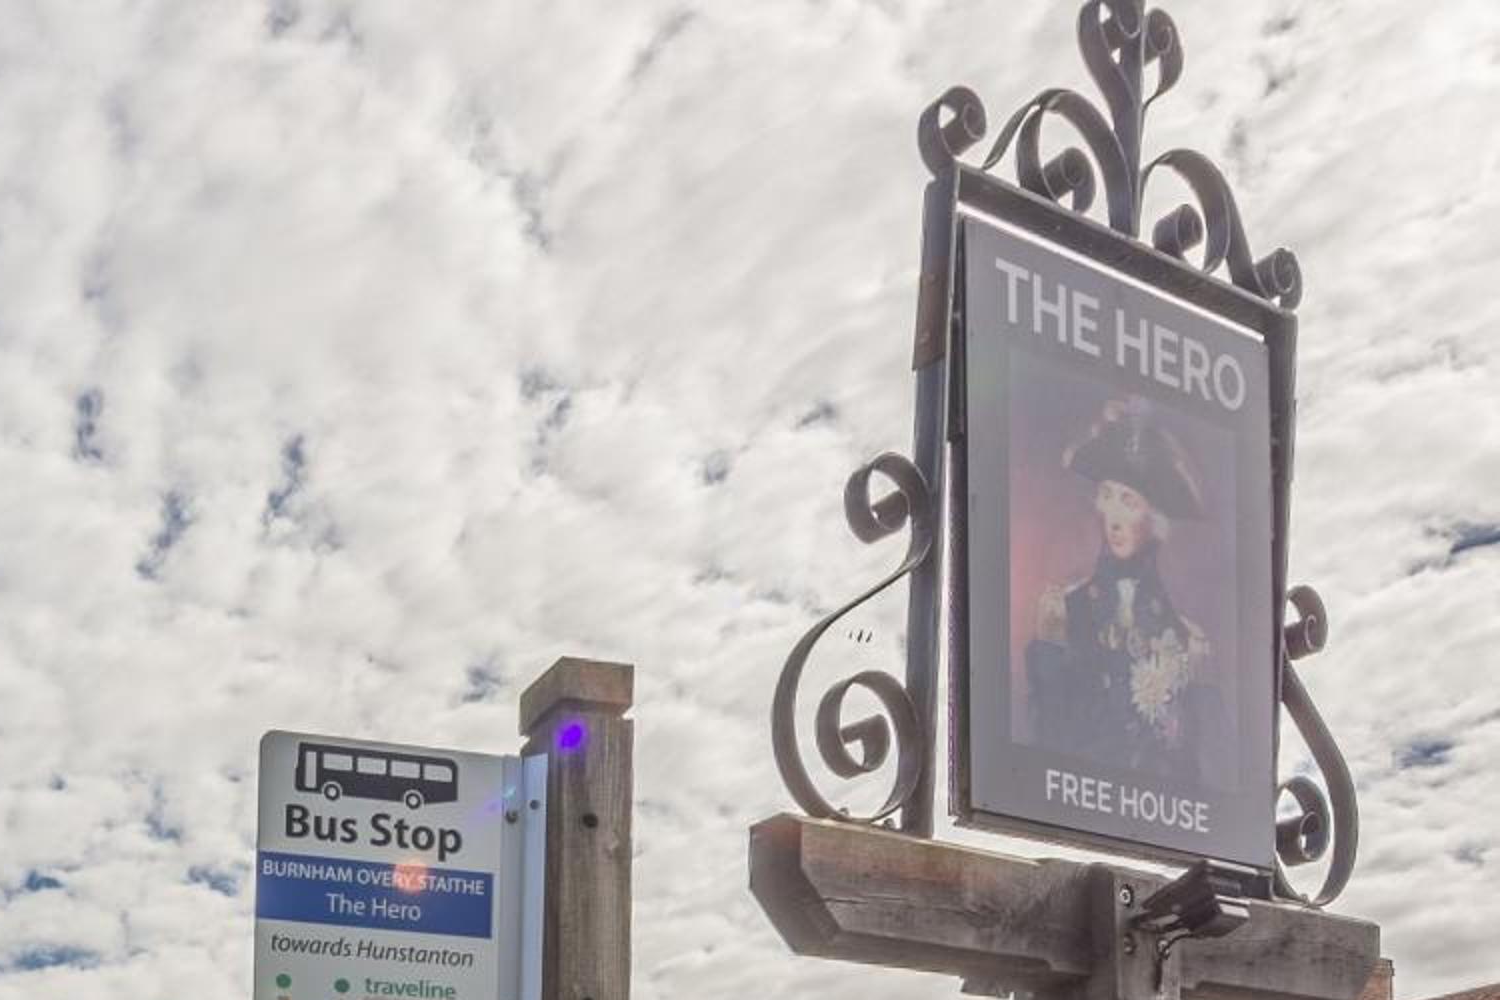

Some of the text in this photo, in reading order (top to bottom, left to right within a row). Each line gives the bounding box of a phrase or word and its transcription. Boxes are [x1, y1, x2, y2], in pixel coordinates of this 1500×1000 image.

[995, 256, 1246, 411] THE HERO
[1045, 768, 1210, 833] FREE HOUSE
[285, 803, 463, 862] Bus Stop
[261, 859, 485, 896] BURNHAM OVERY STAITHE
[326, 892, 422, 921] The Hero
[271, 931, 474, 968] towards Hunstanton
[365, 977, 456, 1000] traveline
